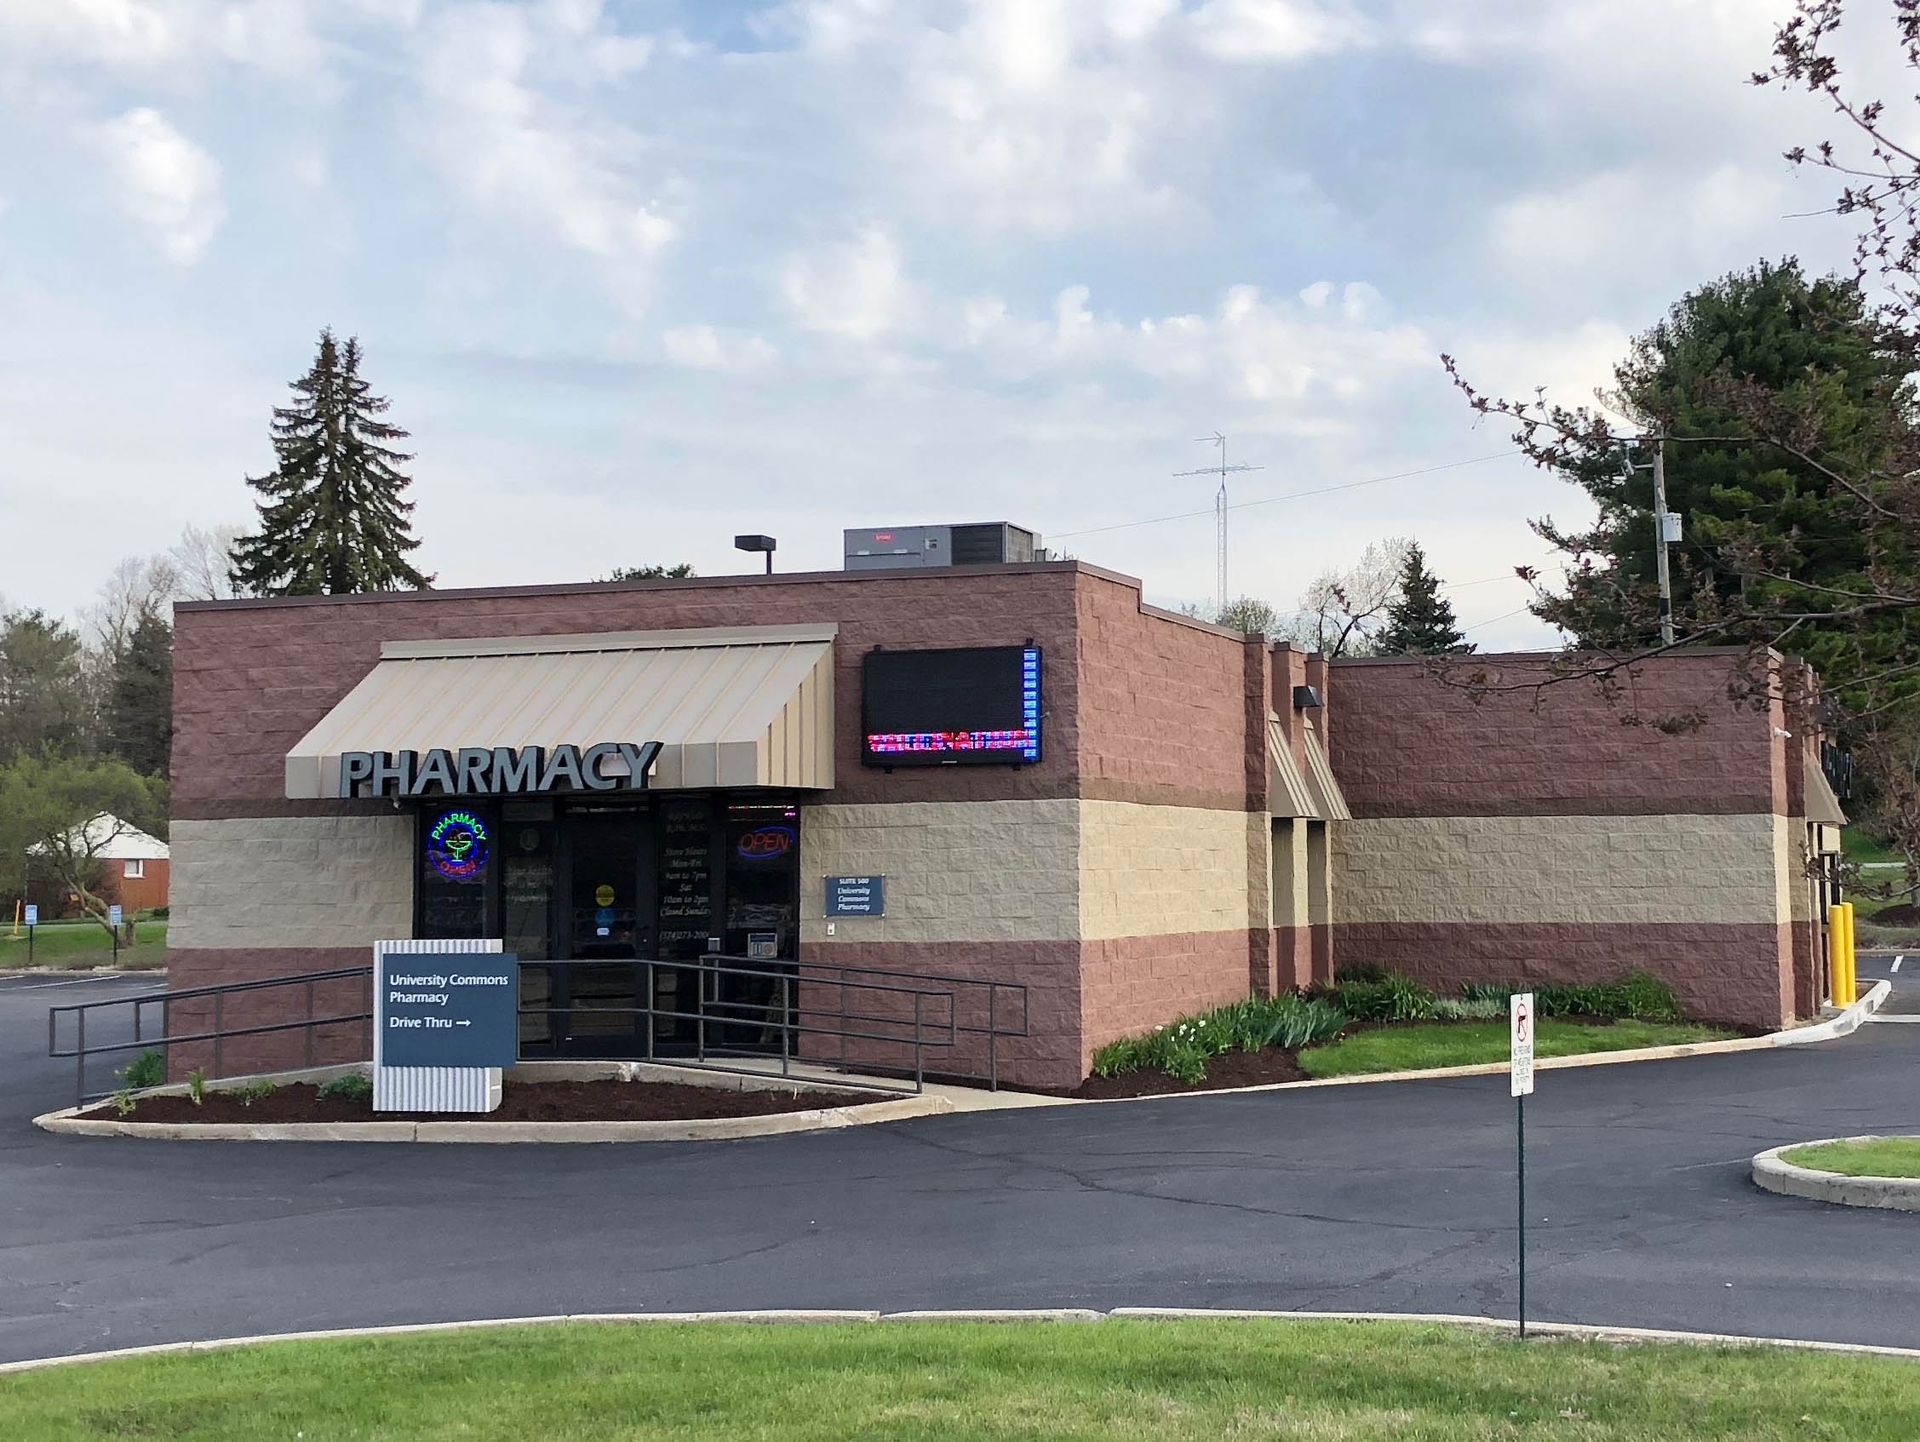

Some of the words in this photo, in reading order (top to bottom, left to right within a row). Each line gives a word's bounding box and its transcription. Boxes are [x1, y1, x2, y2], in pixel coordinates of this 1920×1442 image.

[340, 742, 664, 799] PHARMACY
[431, 813, 486, 840] PHARMACY
[740, 833, 790, 851] OPEN
[440, 860, 476, 875] OPEN
[837, 887, 871, 896] University
[838, 895, 870, 903] Commons
[837, 903, 871, 912] Pharmacy
[389, 974, 448, 989] University
[449, 974, 509, 986] Commons
[389, 991, 449, 1006] Pharmacy
[389, 1016, 422, 1028] Drive
[423, 1016, 453, 1028] Thru
